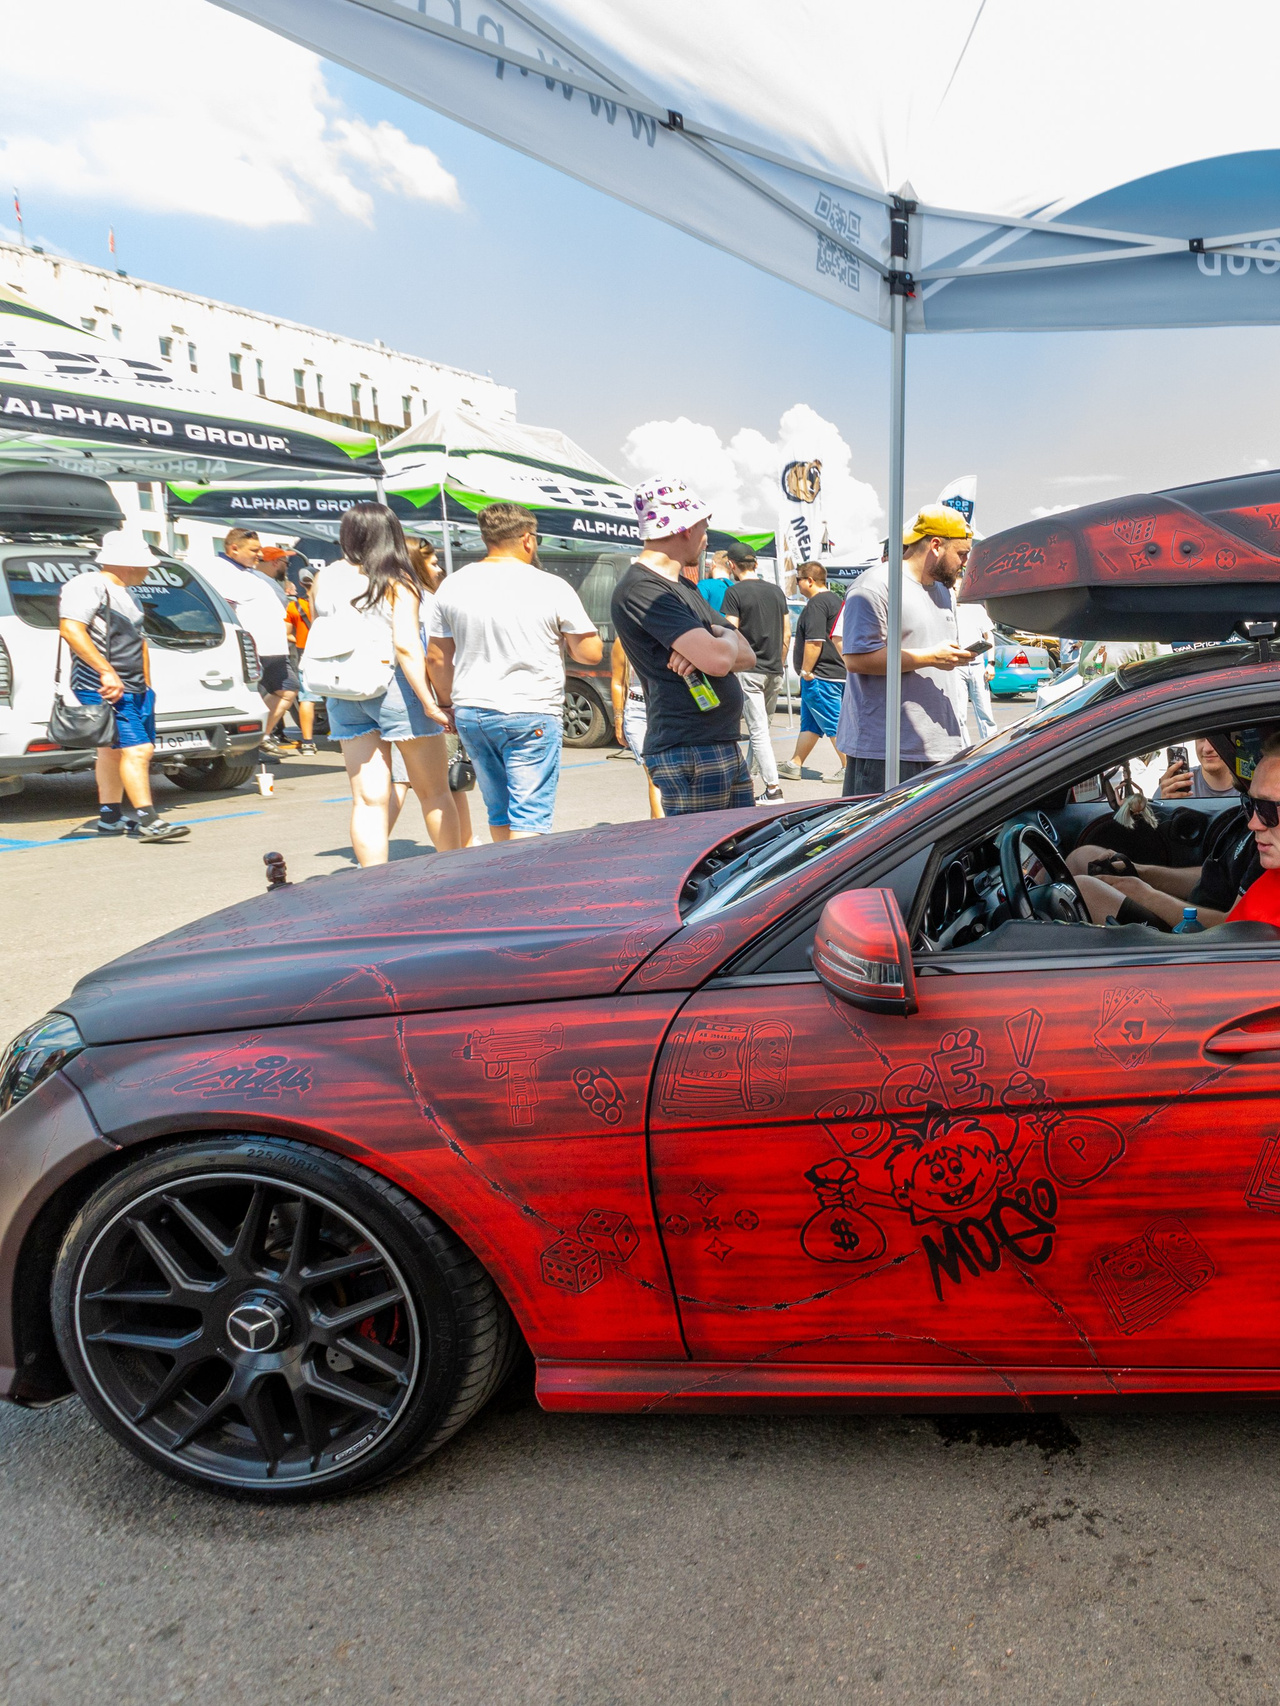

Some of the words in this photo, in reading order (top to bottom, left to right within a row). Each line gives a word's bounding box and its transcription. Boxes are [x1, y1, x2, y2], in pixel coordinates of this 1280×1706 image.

[3, 397, 174, 436] ALPHARD
[230, 497, 311, 511] ALPHARD
[573, 518, 640, 538] ALPHAR
[187, 732, 202, 742] 71
